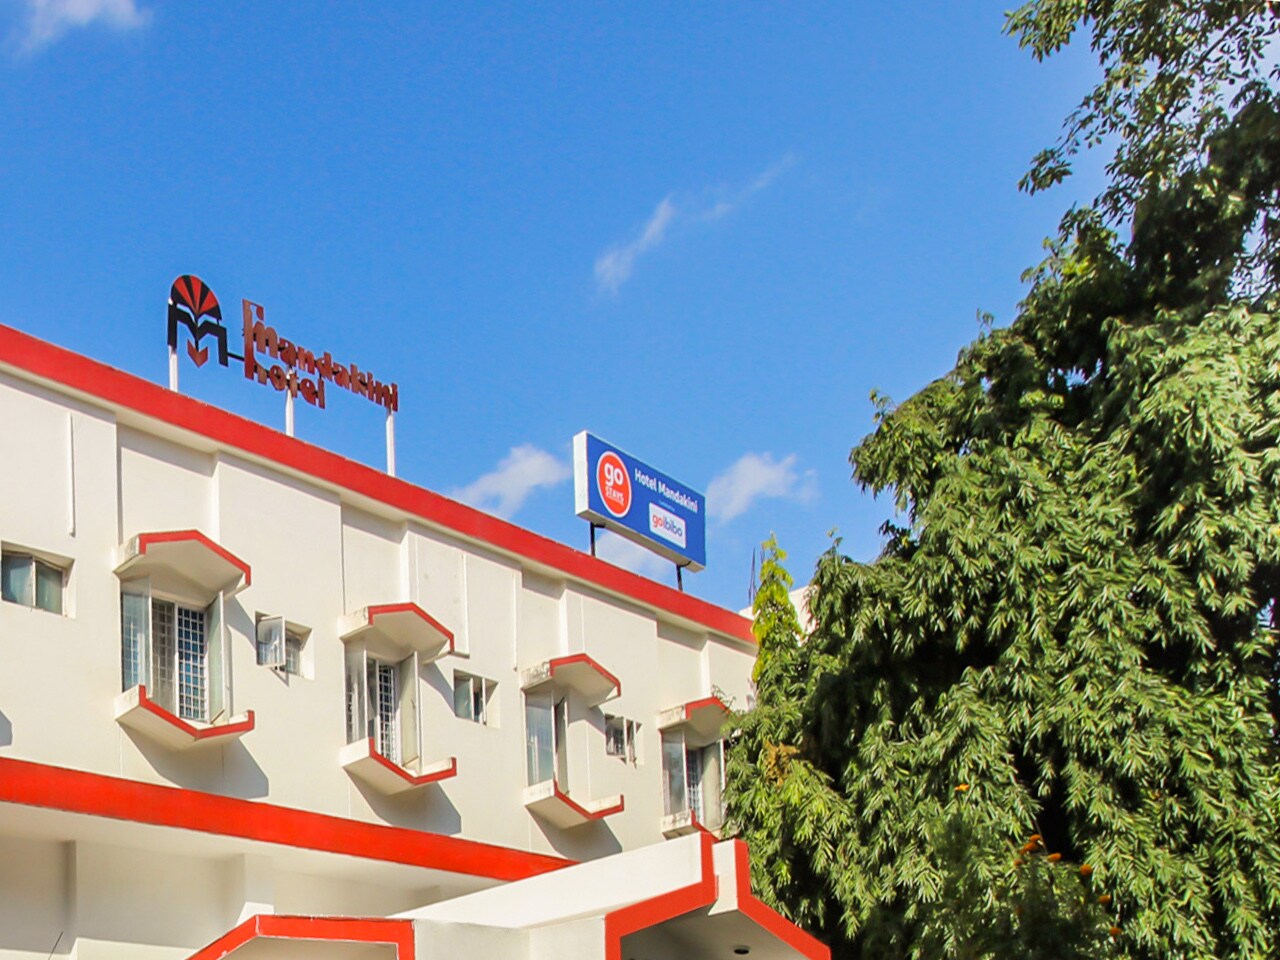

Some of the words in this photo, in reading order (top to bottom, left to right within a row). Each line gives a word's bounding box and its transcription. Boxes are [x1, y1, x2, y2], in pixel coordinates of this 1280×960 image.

[604, 463, 624, 487] go
[635, 468, 657, 492] Hotel
[658, 480, 698, 513] Mandakini
